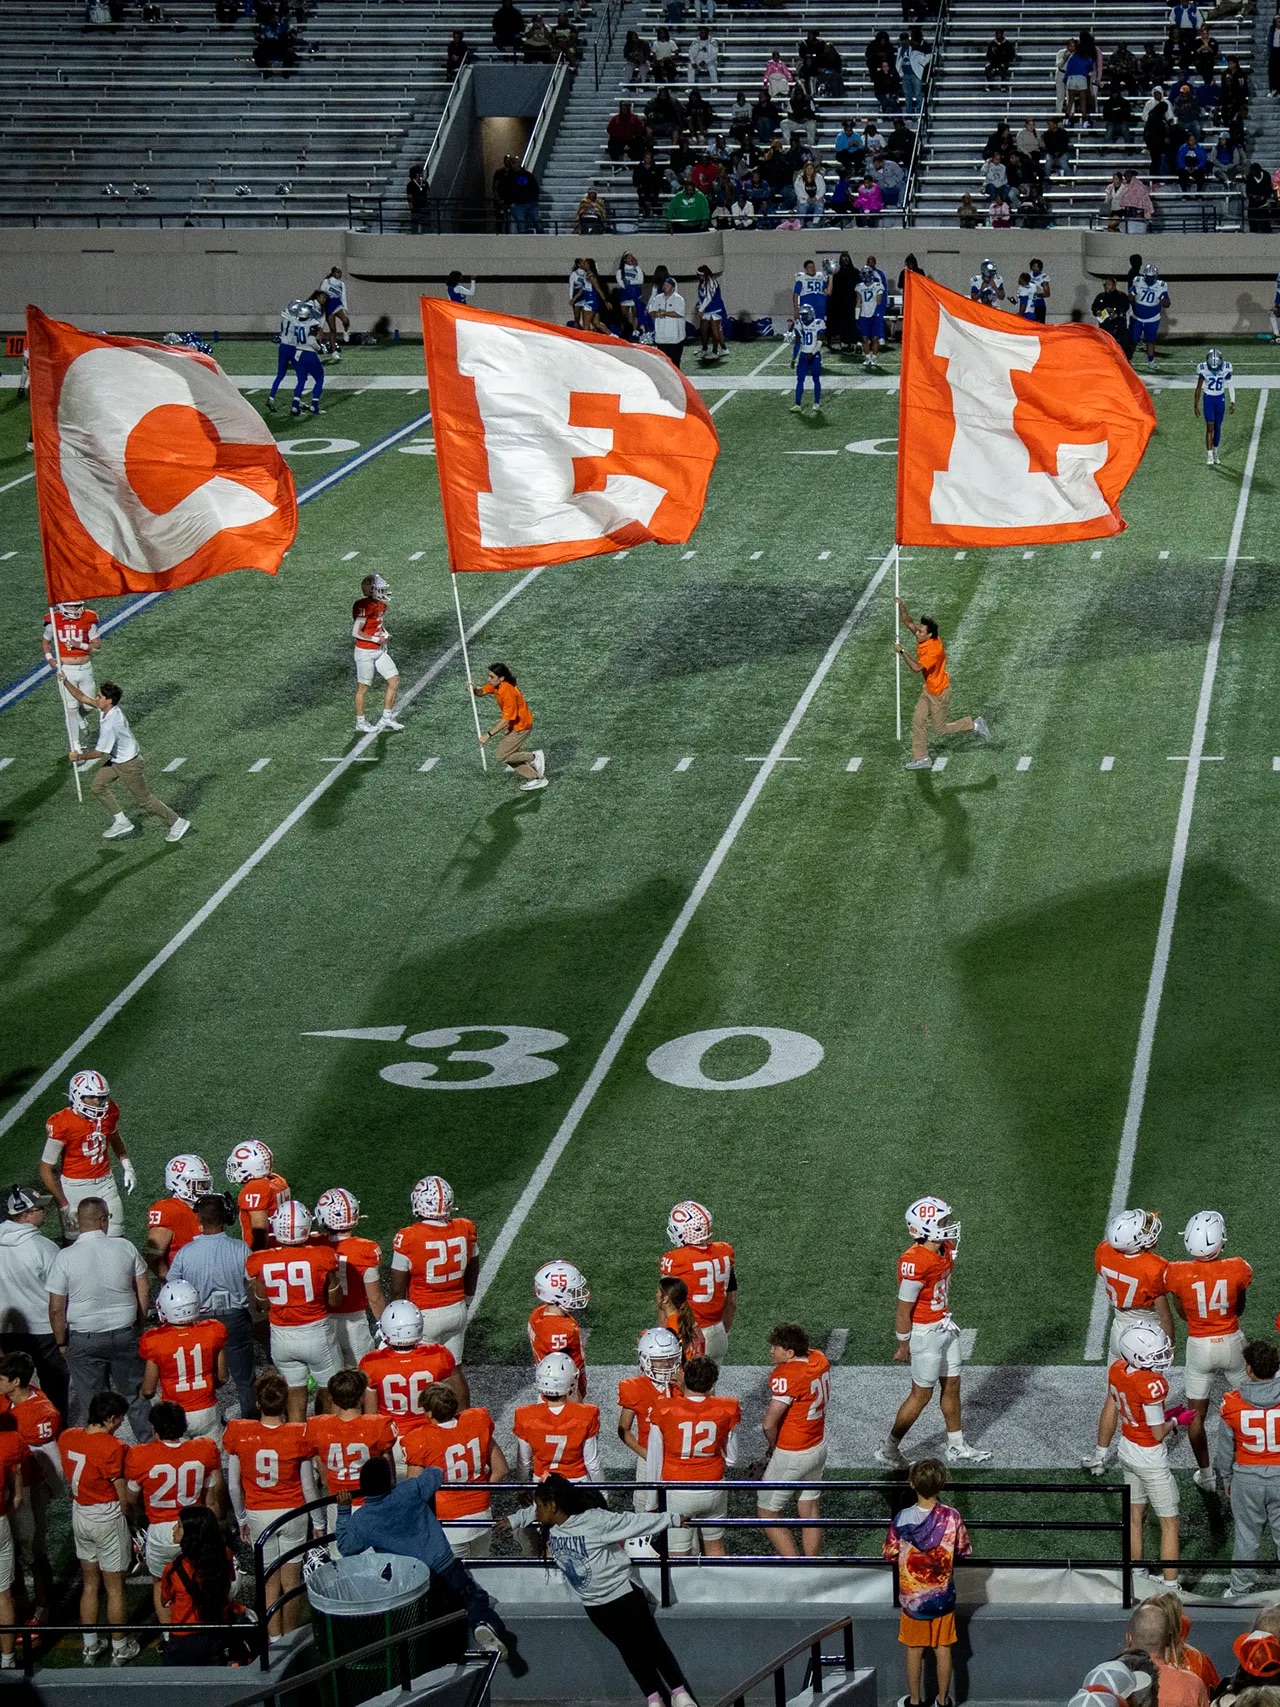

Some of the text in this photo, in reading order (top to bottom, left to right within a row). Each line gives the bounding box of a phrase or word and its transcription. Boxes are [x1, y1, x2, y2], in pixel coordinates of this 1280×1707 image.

[1140, 290, 1155, 303] 70
[10, 338, 24, 354] 10
[1208, 377, 1223, 391] 26
[59, 344, 278, 573] C
[455, 319, 687, 547] E
[930, 302, 1110, 527] L
[58, 629, 84, 650] 44
[235, 1148, 251, 1160] C
[171, 1161, 187, 1173] 53
[245, 1193, 261, 1207] 47
[672, 1209, 688, 1223] C
[919, 1206, 936, 1218] 80
[425, 1236, 467, 1284] 23
[901, 1262, 916, 1276] 80
[263, 1261, 314, 1305] 59
[550, 1274, 567, 1287] 55
[692, 1255, 731, 1303] 34
[1191, 1279, 1230, 1319] 14
[551, 1333, 568, 1349] 55
[173, 1344, 207, 1392] 11
[771, 1378, 788, 1394] 20
[1147, 1380, 1165, 1399] 21
[37, 1421, 52, 1439] 15
[677, 1421, 717, 1459] 12
[327, 1442, 371, 1480] 42
[445, 1437, 482, 1483] 61
[545, 1434, 568, 1469] 7
[67, 1450, 86, 1497] 7
[255, 1449, 279, 1488] 9
[148, 1460, 205, 1508] 20
